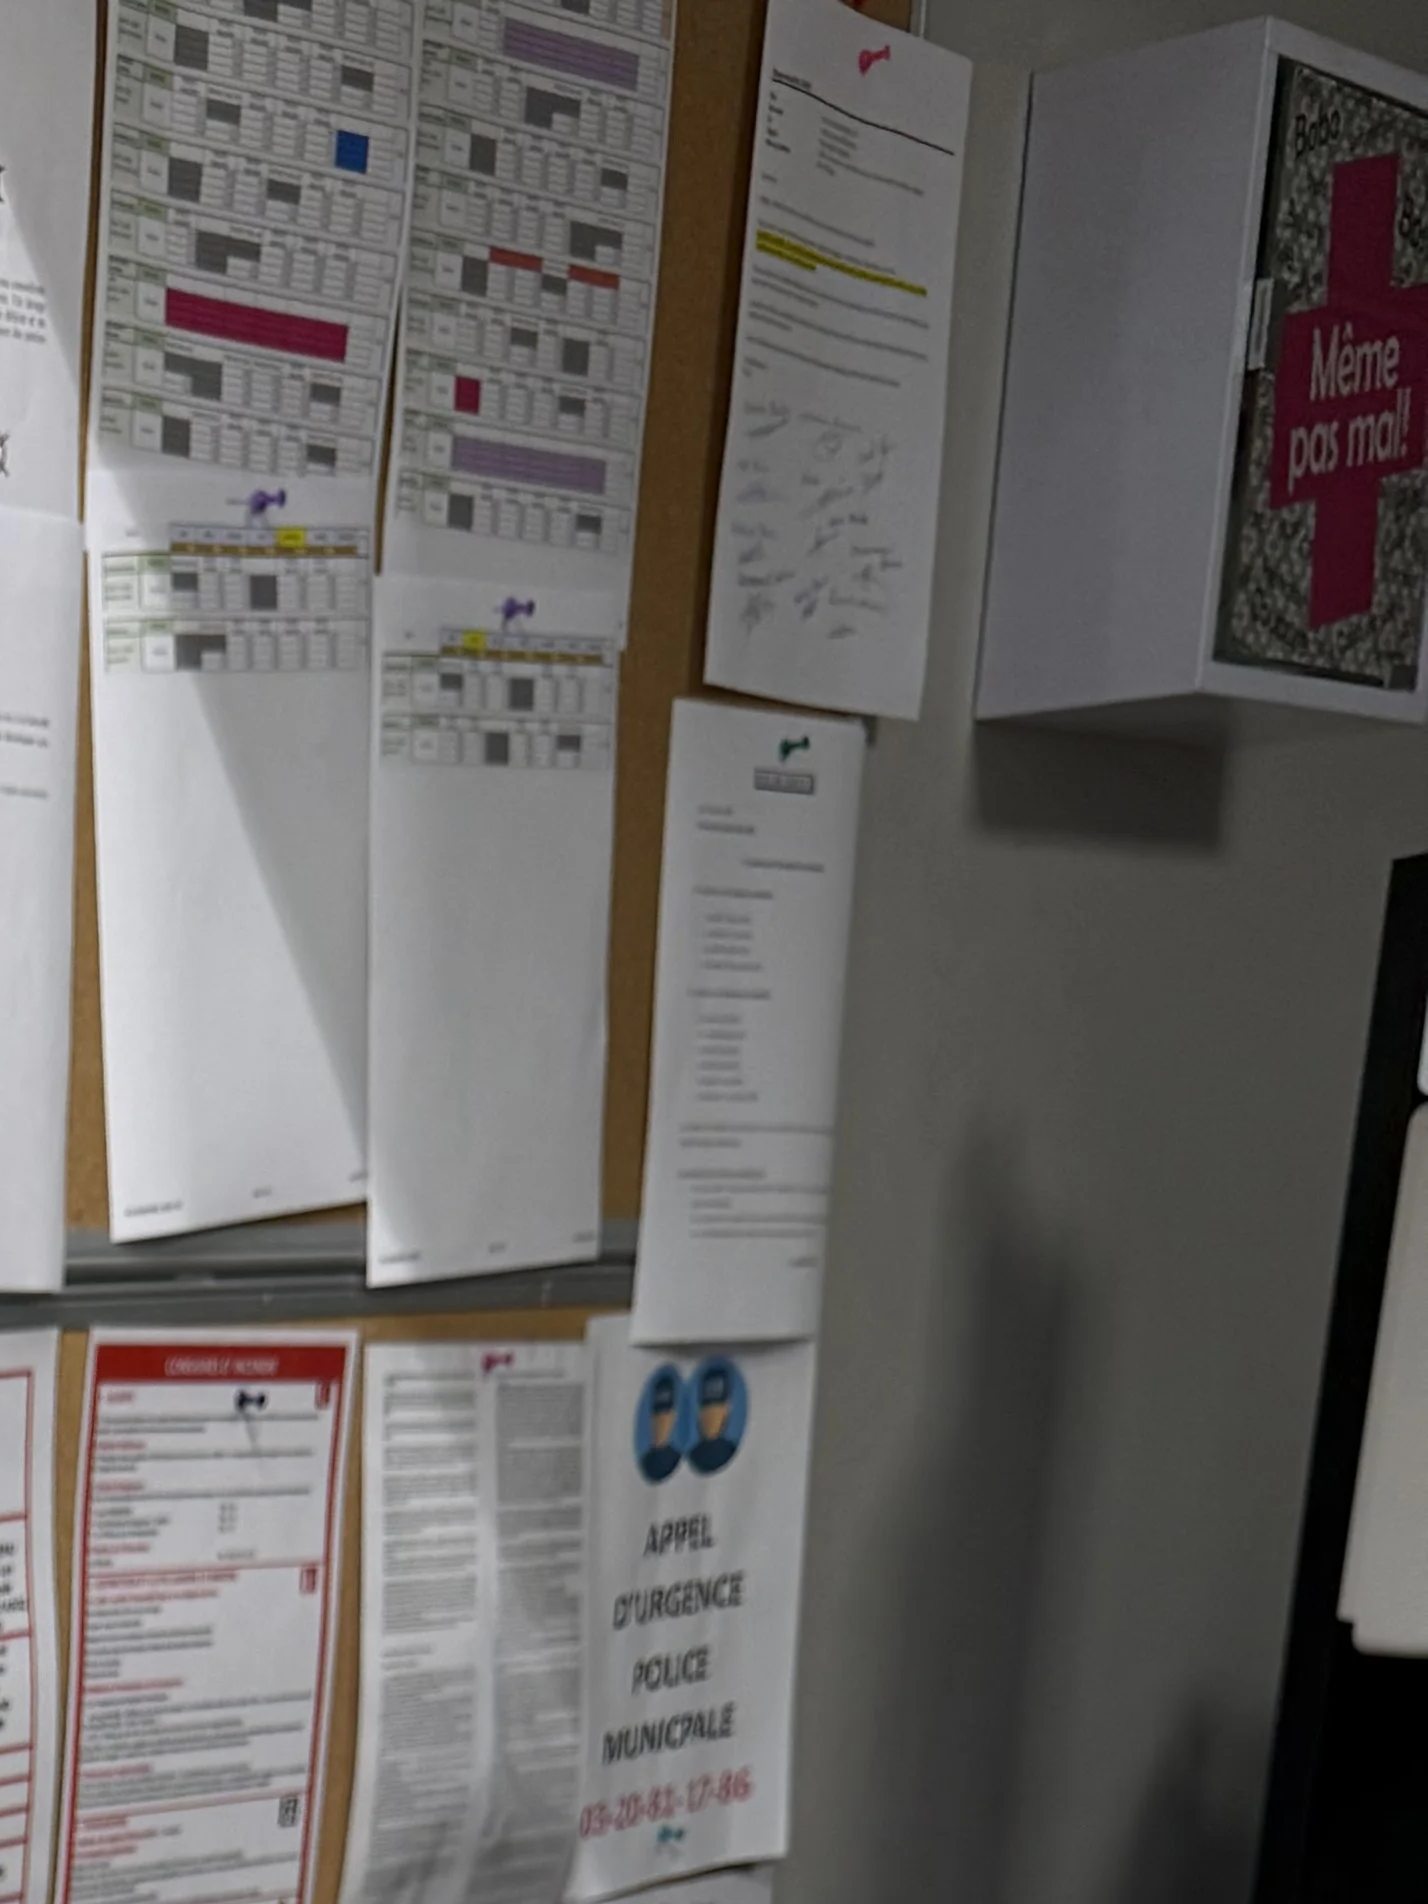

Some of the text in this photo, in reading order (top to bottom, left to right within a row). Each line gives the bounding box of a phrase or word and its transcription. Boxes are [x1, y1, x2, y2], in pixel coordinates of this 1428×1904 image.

[1309, 322, 1401, 402] Même
[1286, 387, 1411, 494] pas mal!
[644, 1512, 716, 1558] APPEL
[612, 1569, 747, 1632] D'URGENCE
[631, 1644, 710, 1697] POLICE
